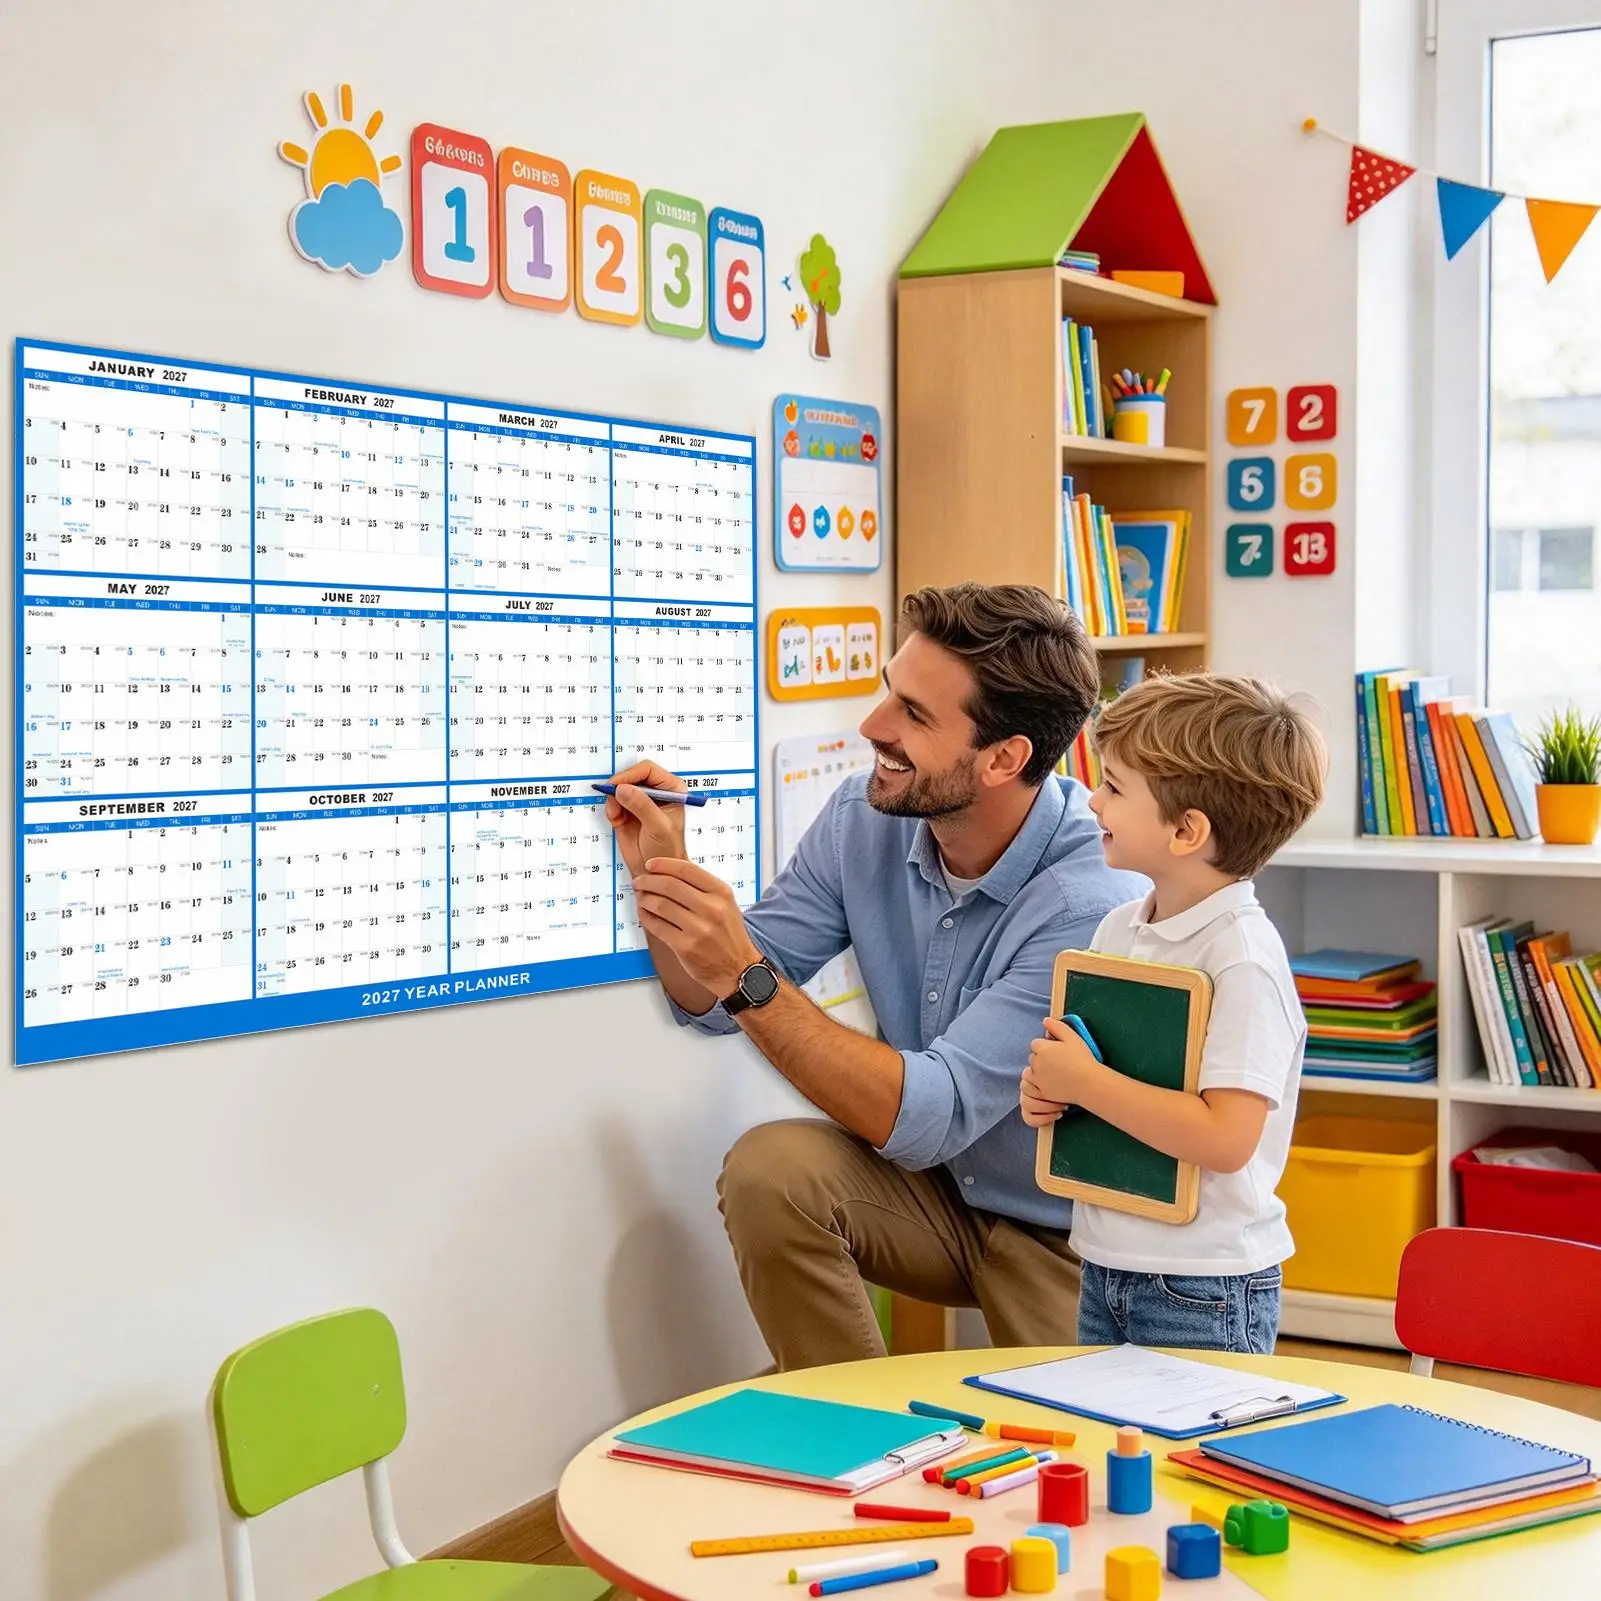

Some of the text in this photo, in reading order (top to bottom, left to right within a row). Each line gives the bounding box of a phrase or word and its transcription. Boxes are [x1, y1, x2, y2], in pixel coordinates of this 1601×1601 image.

[444, 186, 475, 263] 1
[523, 205, 553, 280] 1
[595, 225, 626, 294] 2
[664, 243, 691, 308] 3
[726, 259, 753, 321] 6
[89, 361, 187, 382] JANUARY 2027
[304, 389, 394, 408] FEBRUARY 2027
[499, 414, 558, 429] MARCH 2027
[1242, 399, 1266, 433] 7
[1297, 394, 1324, 431] 2
[659, 435, 705, 447] APRIL 2027
[25, 457, 37, 465] 10
[61, 460, 71, 468] 11
[95, 463, 105, 471] 12
[128, 466, 139, 474] 13
[159, 469, 170, 477] 14
[221, 474, 231, 482] 16
[256, 476, 265, 484] 14
[314, 482, 323, 490] 16
[1240, 466, 1264, 502] 5
[1299, 465, 1323, 498] 6
[25, 495, 36, 503] 17
[61, 497, 71, 505] 18
[95, 500, 105, 508] 19
[128, 502, 139, 510] 20
[191, 507, 201, 515] 22
[221, 509, 232, 517] 23
[108, 583, 170, 595] MAY 2027
[322, 593, 381, 604] JUNE 2027
[506, 601, 554, 610] JULY 2027
[656, 607, 691, 616] AUGUST
[25, 684, 231, 693] 9 10 11 12 13 14 15
[256, 685, 266, 693] 13
[285, 685, 295, 693] 14
[314, 685, 323, 693] 15
[342, 685, 351, 693] 16
[395, 685, 404, 693] 18
[25, 720, 232, 731] 16 17 18 19 20 21 22
[491, 785, 571, 796] NOVEMBER 2027
[703, 778, 718, 787] 2027
[79, 801, 198, 816] SEPTEMBER 2027
[309, 792, 394, 805] OCTOBER 2027
[451, 877, 459, 885] 14
[476, 875, 484, 883] 15
[500, 873, 508, 881] 16
[524, 871, 532, 879] 17
[547, 869, 554, 877] 18
[570, 867, 577, 875] 19
[257, 893, 267, 901] 10
[286, 891, 295, 899] 11
[370, 884, 378, 892] 14
[396, 882, 404, 890] 15
[422, 880, 430, 888] 16
[25, 896, 233, 921] 12 13 14 15 16 17 18
[25, 931, 233, 960] 19 20 21 22 23 24 25
[361, 973, 530, 1006] 2027 YEAR PLANNER
